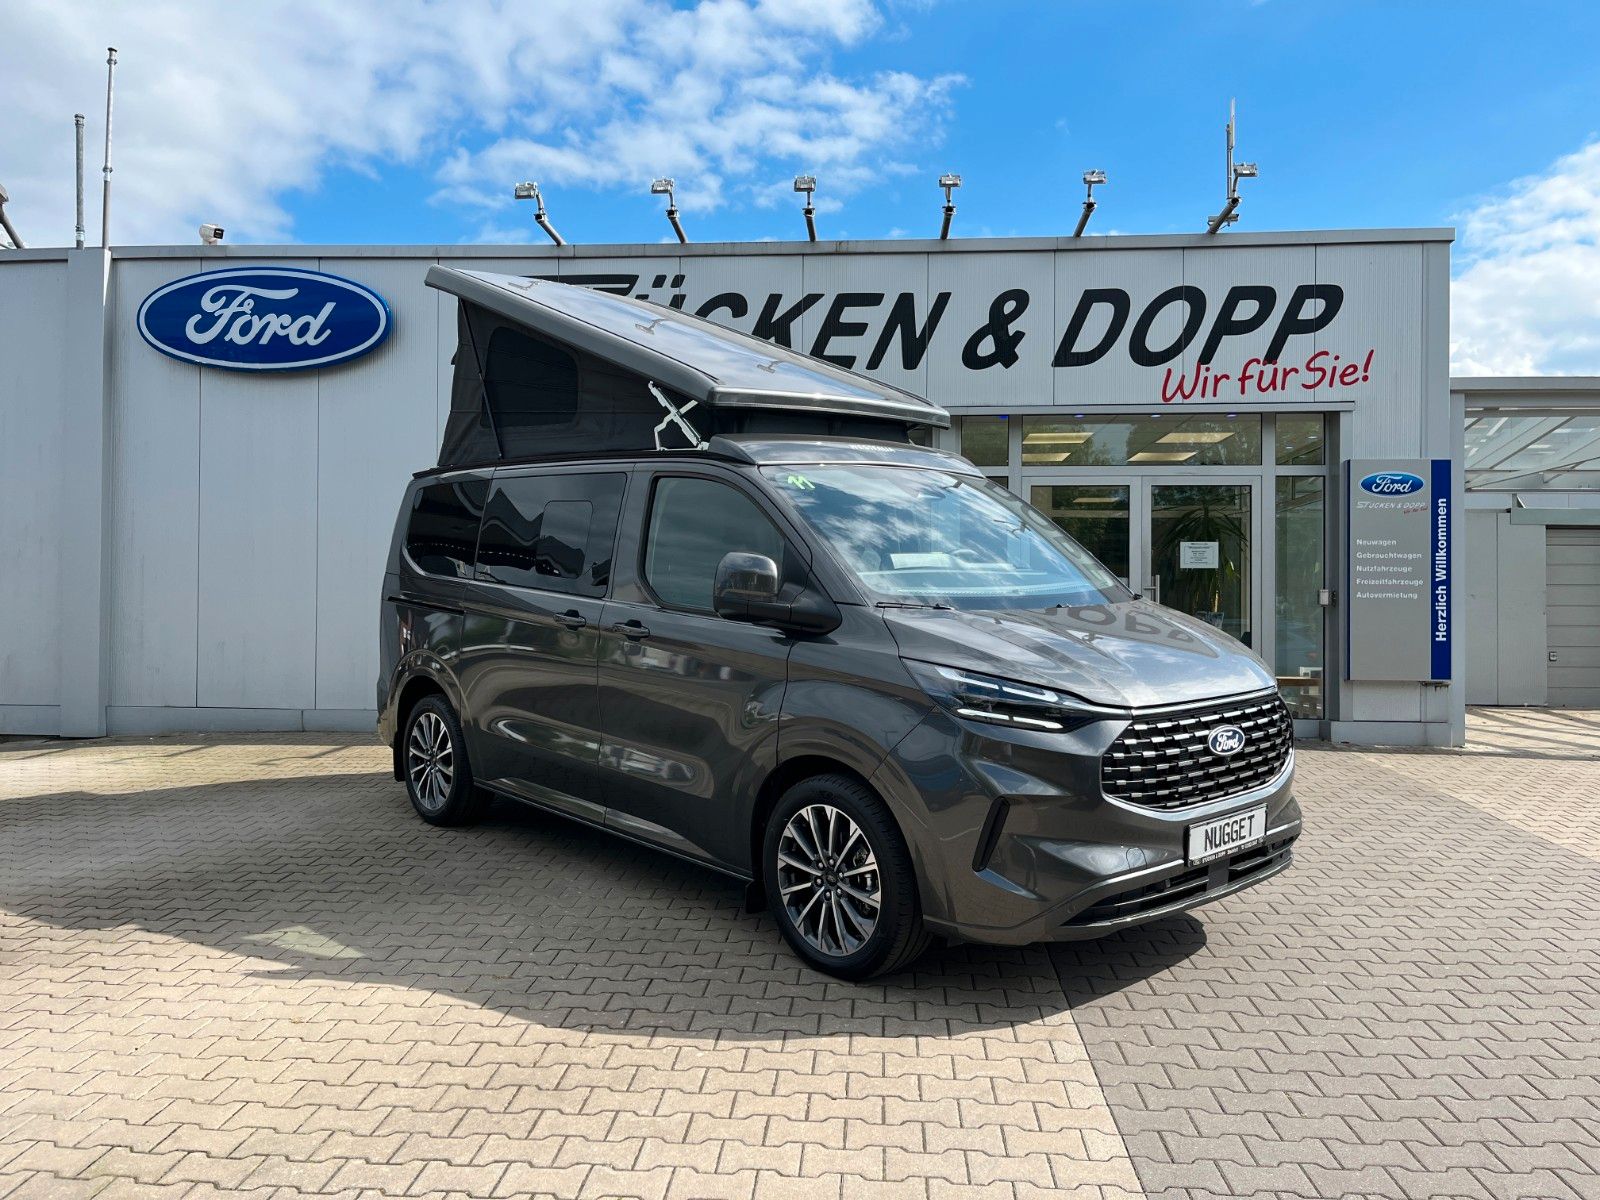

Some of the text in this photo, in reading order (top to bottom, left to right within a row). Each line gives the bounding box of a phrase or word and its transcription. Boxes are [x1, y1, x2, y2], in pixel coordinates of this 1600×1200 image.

[185, 284, 337, 346] Ford
[530, 274, 1345, 371] CKEN & DOPP
[1161, 349, 1375, 402] Wir für Sie!
[1371, 474, 1413, 493] Ford
[1356, 538, 1397, 547] Neuwagen
[1356, 551, 1422, 560] Gebrauchtwagen
[1356, 564, 1413, 574] Nutzfahrzeuge
[1435, 498, 1447, 642] Herzlich Willkommen
[1356, 578, 1424, 587] Freizeitfahrzeuge
[1356, 591, 1418, 600] Autovermietung
[1216, 730, 1240, 751] Ford
[1204, 813, 1255, 853] NUGGET
